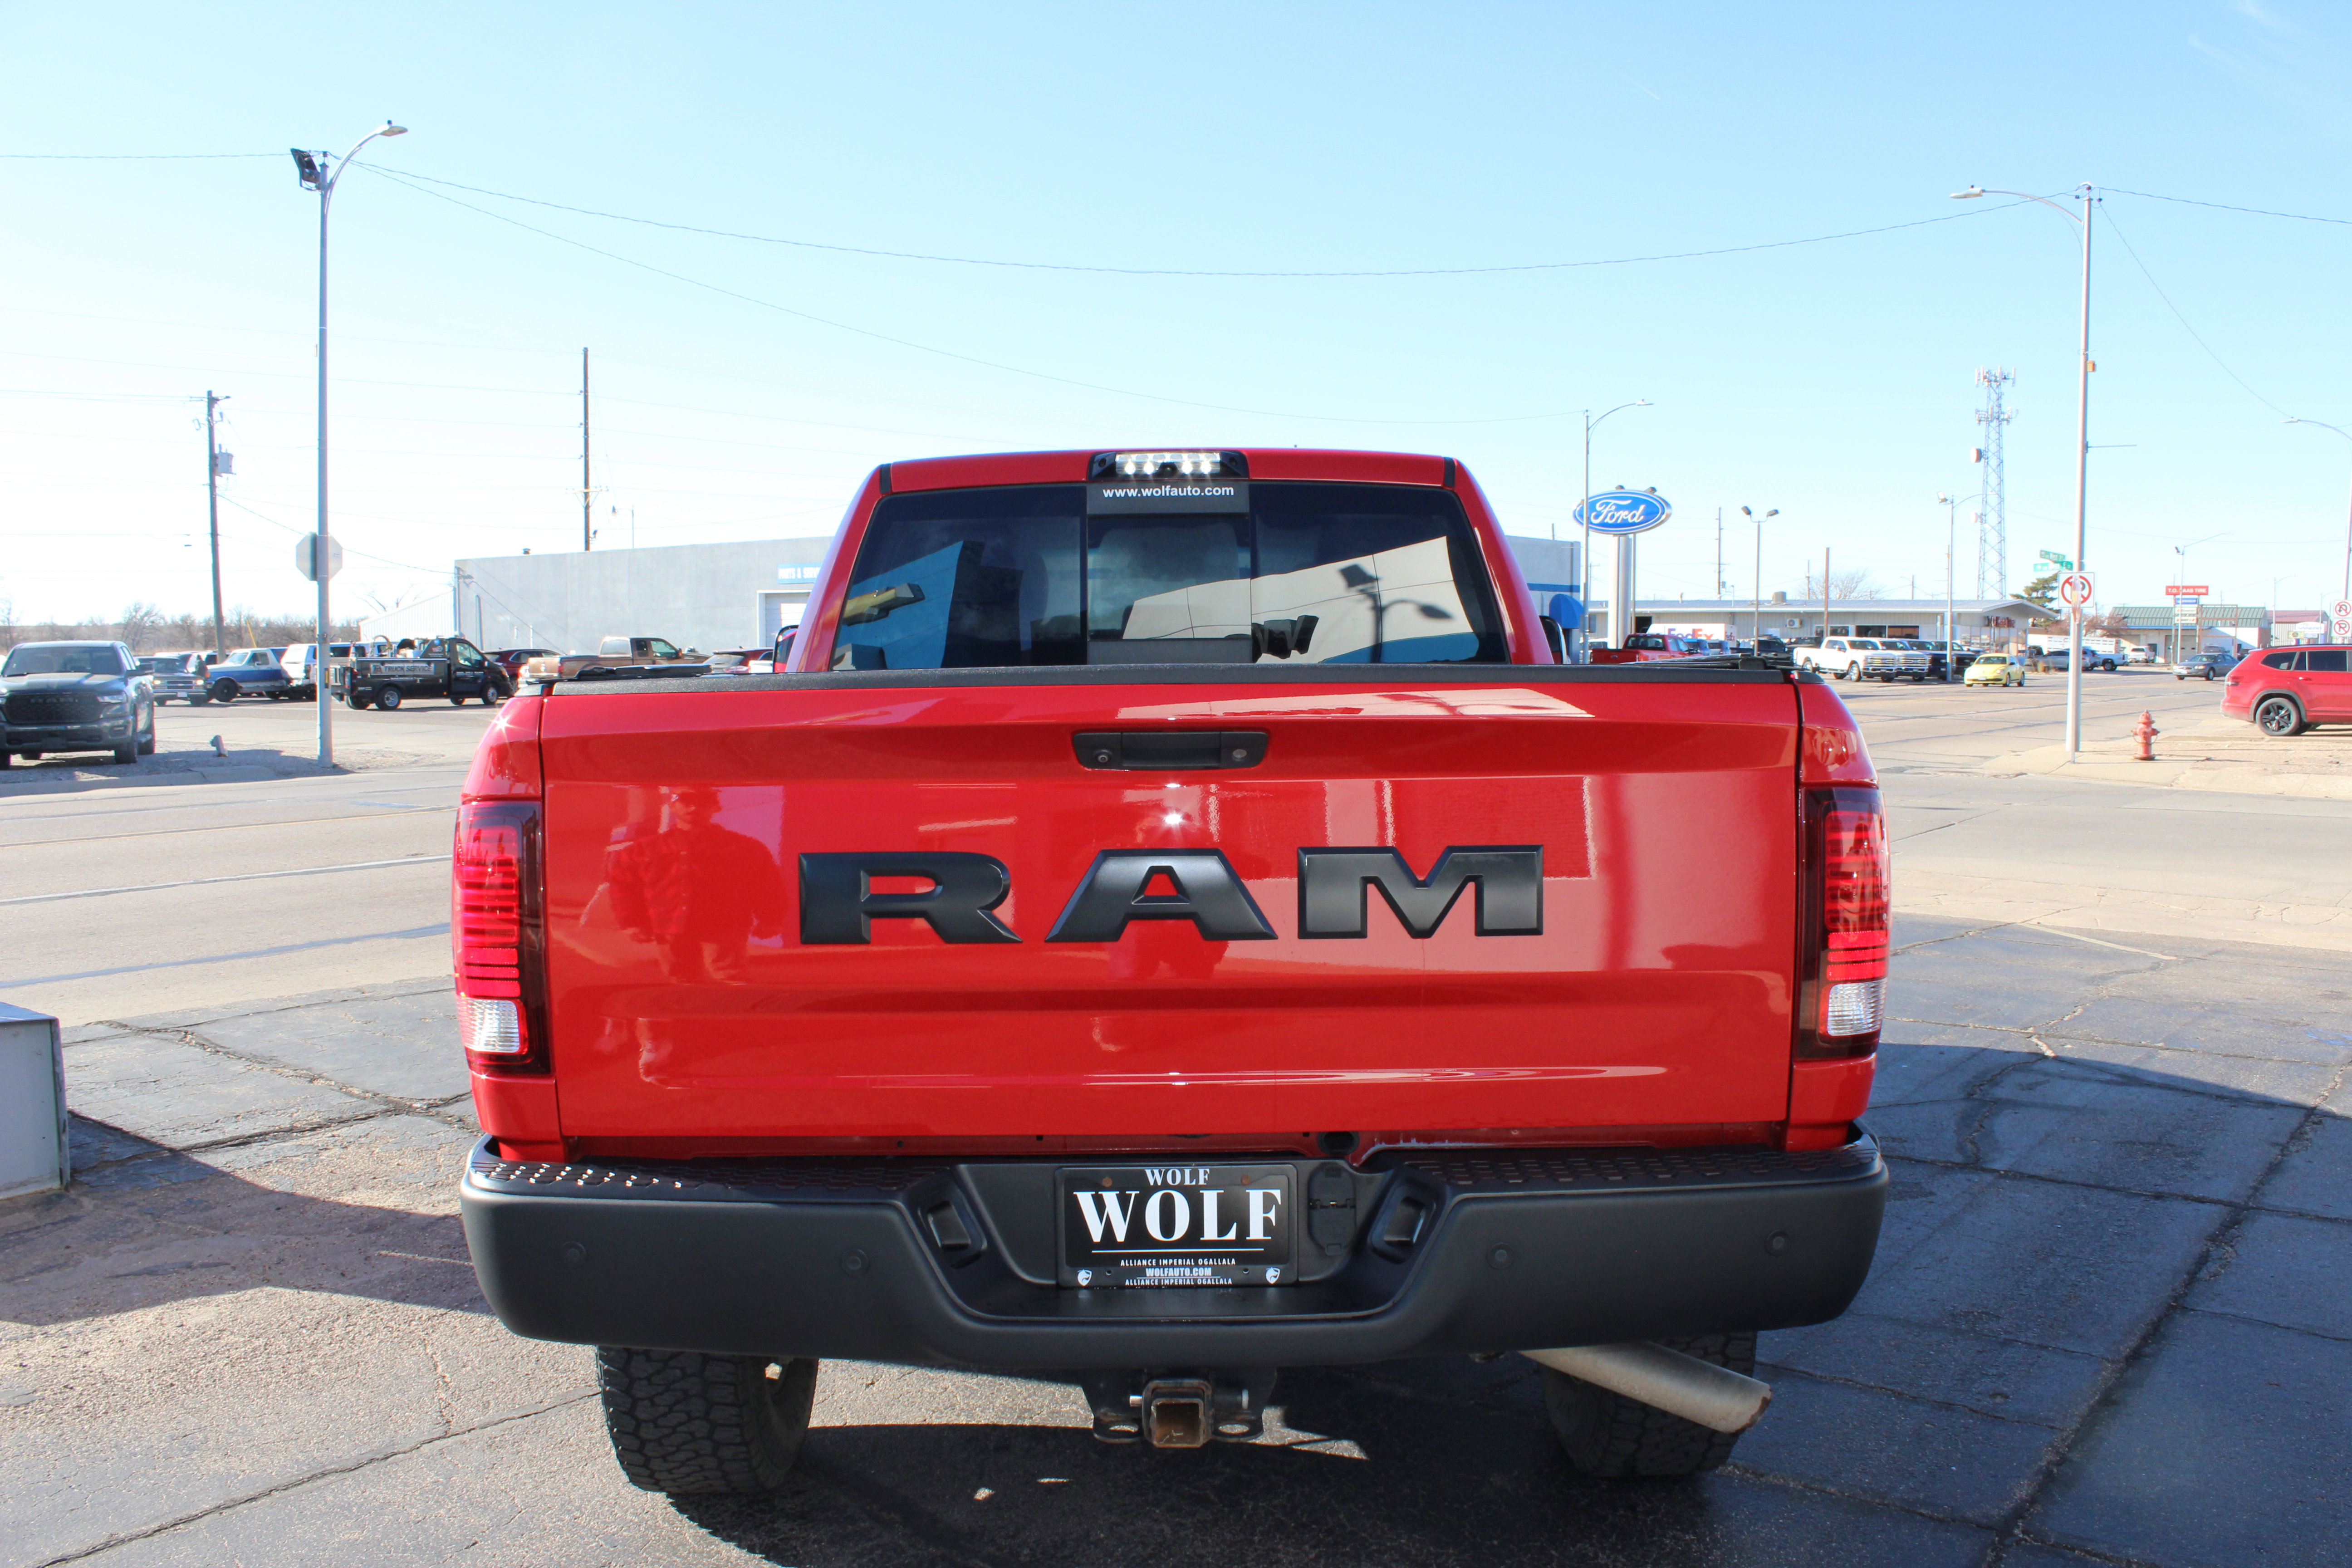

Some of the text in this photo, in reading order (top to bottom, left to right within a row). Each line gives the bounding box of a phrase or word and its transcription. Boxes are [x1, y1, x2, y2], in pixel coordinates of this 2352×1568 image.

[1102, 485, 1235, 498] www.wolfauto.com
[1591, 500, 1646, 524] Ford
[779, 568, 795, 579] PARTS
[797, 567, 802, 578] &
[799, 844, 1544, 945] RAM
[1145, 1168, 1210, 1186] WOLF
[1073, 1189, 1281, 1243] WOLF
[1145, 1267, 1212, 1277] WOLFAUTO.COM
